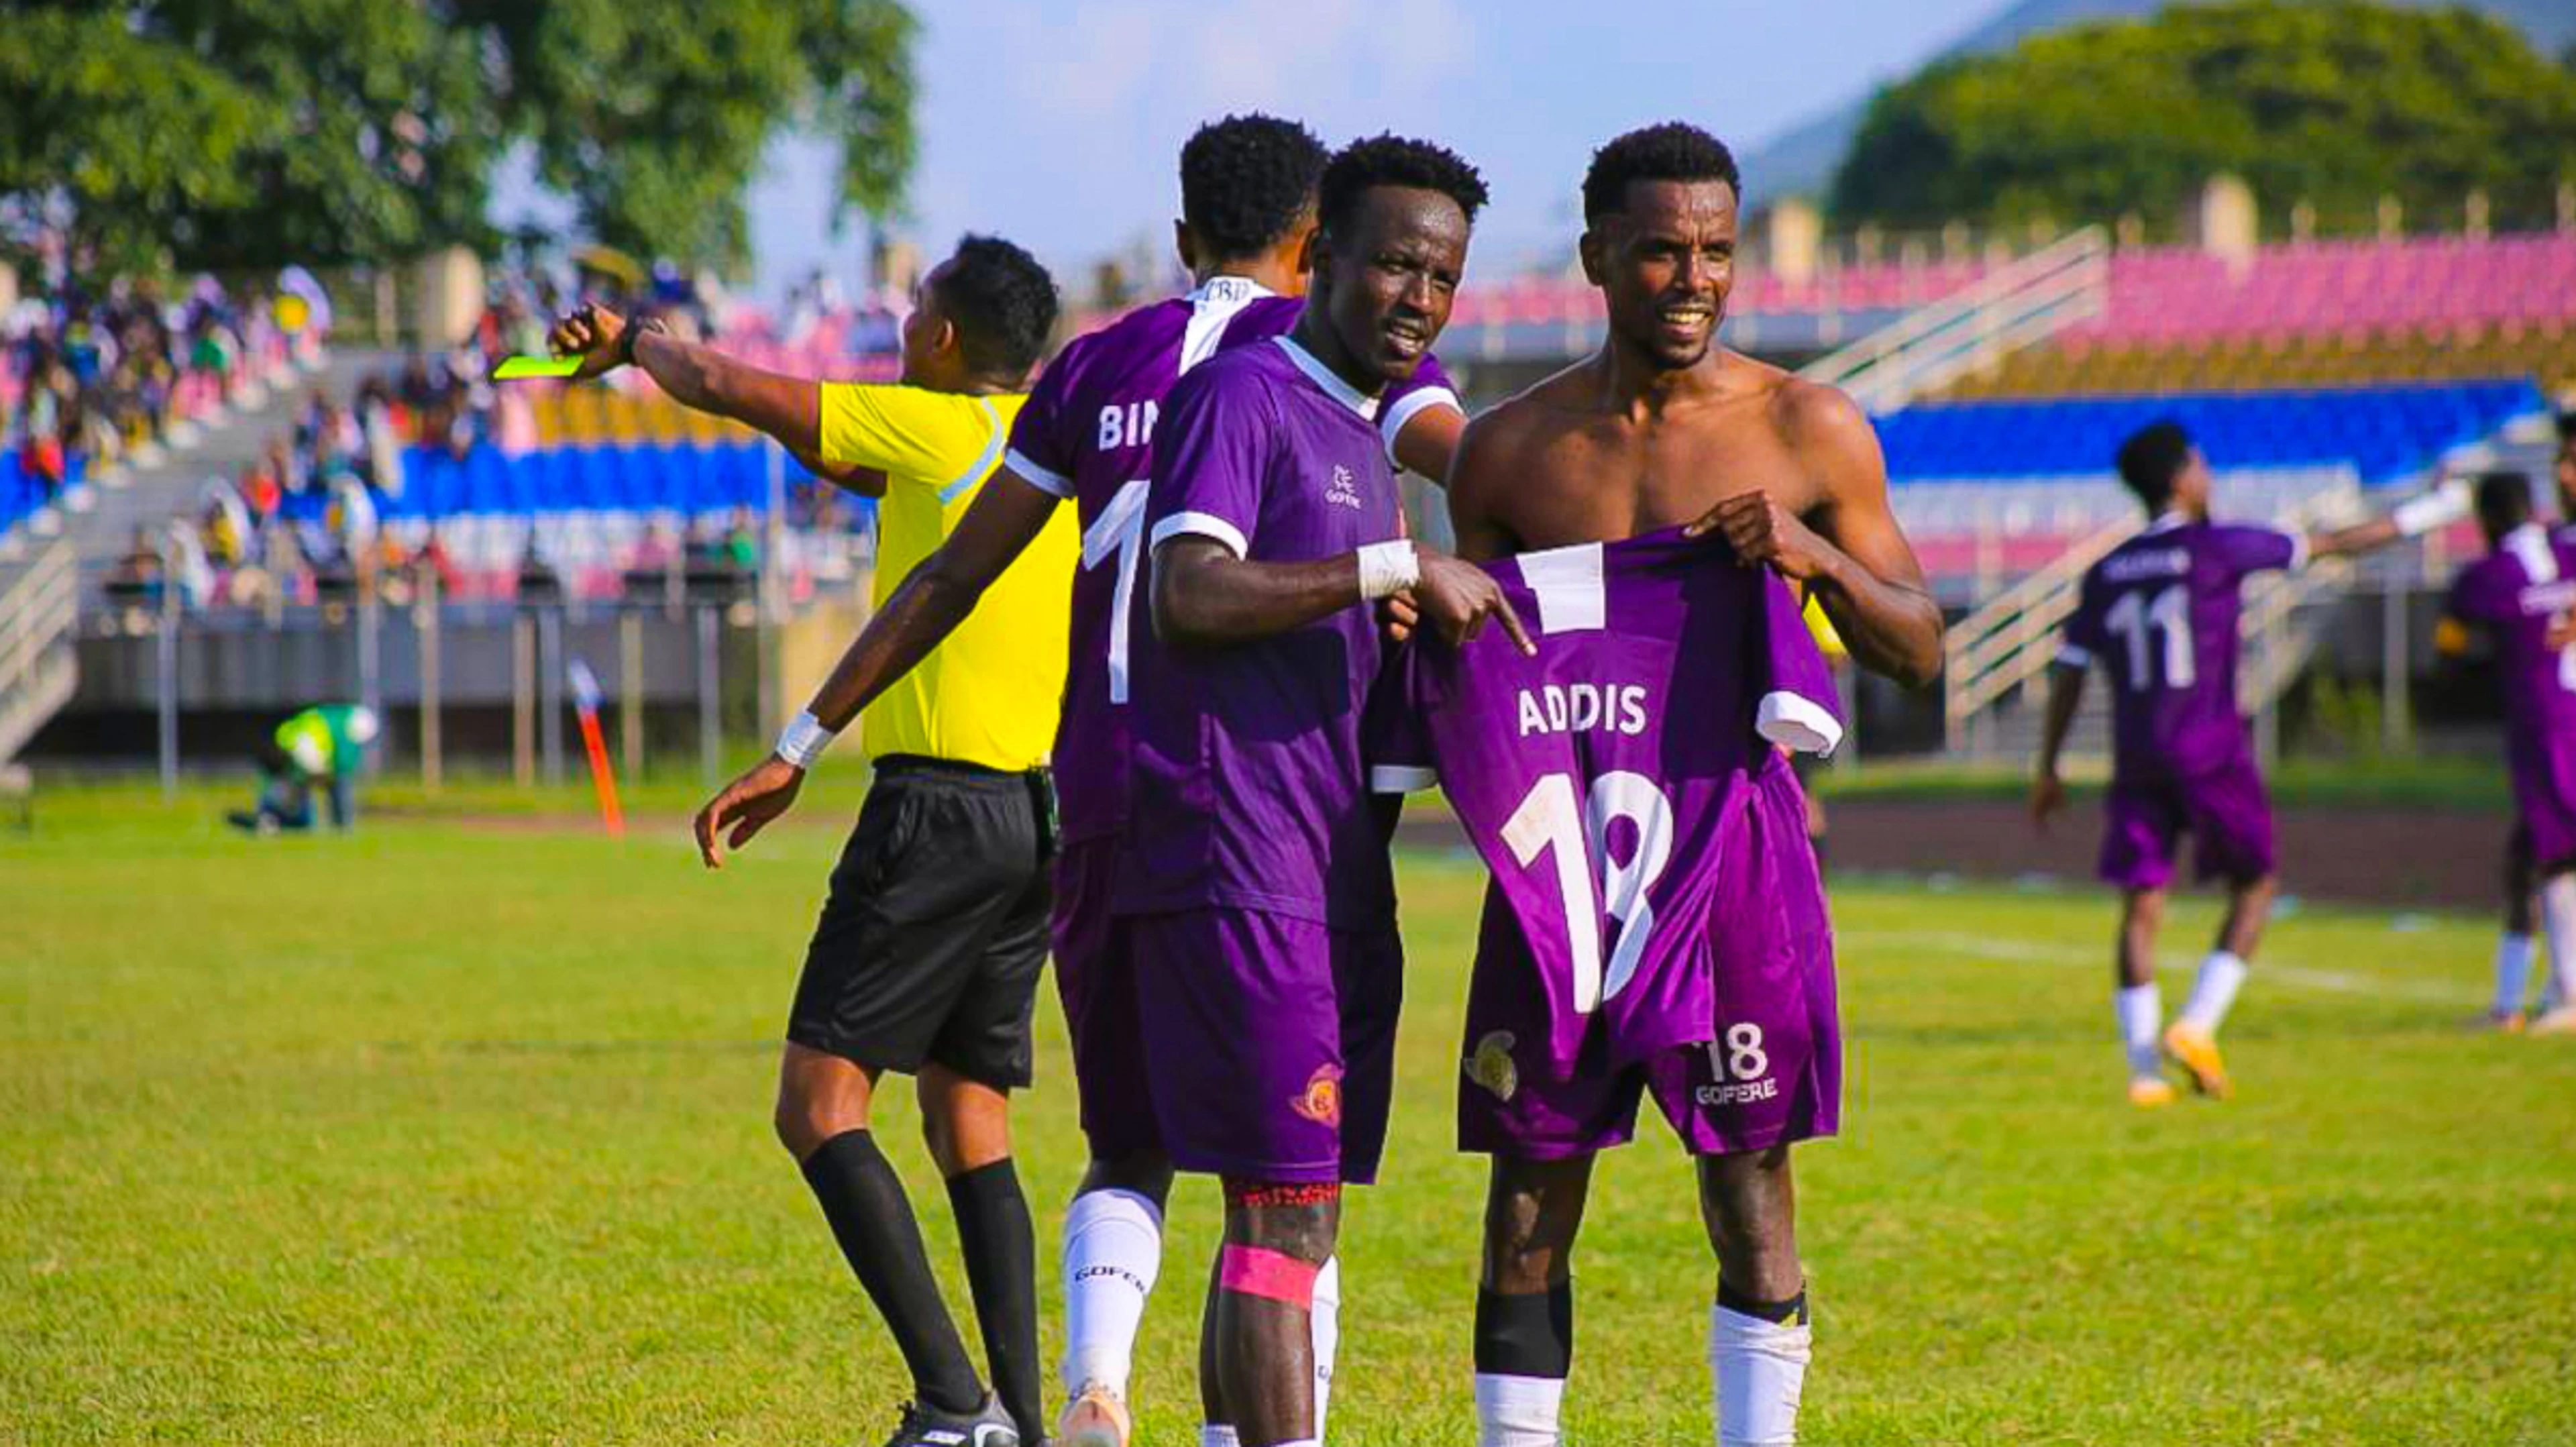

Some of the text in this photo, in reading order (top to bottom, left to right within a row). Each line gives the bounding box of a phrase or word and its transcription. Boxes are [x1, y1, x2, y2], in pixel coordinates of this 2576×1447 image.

[2104, 583, 2196, 691] 11
[1519, 683, 1646, 737] ADDIS
[1499, 770, 1674, 1014] 18
[1692, 1022, 1768, 1083] 18
[1695, 1077, 1779, 1105] GOFERE
